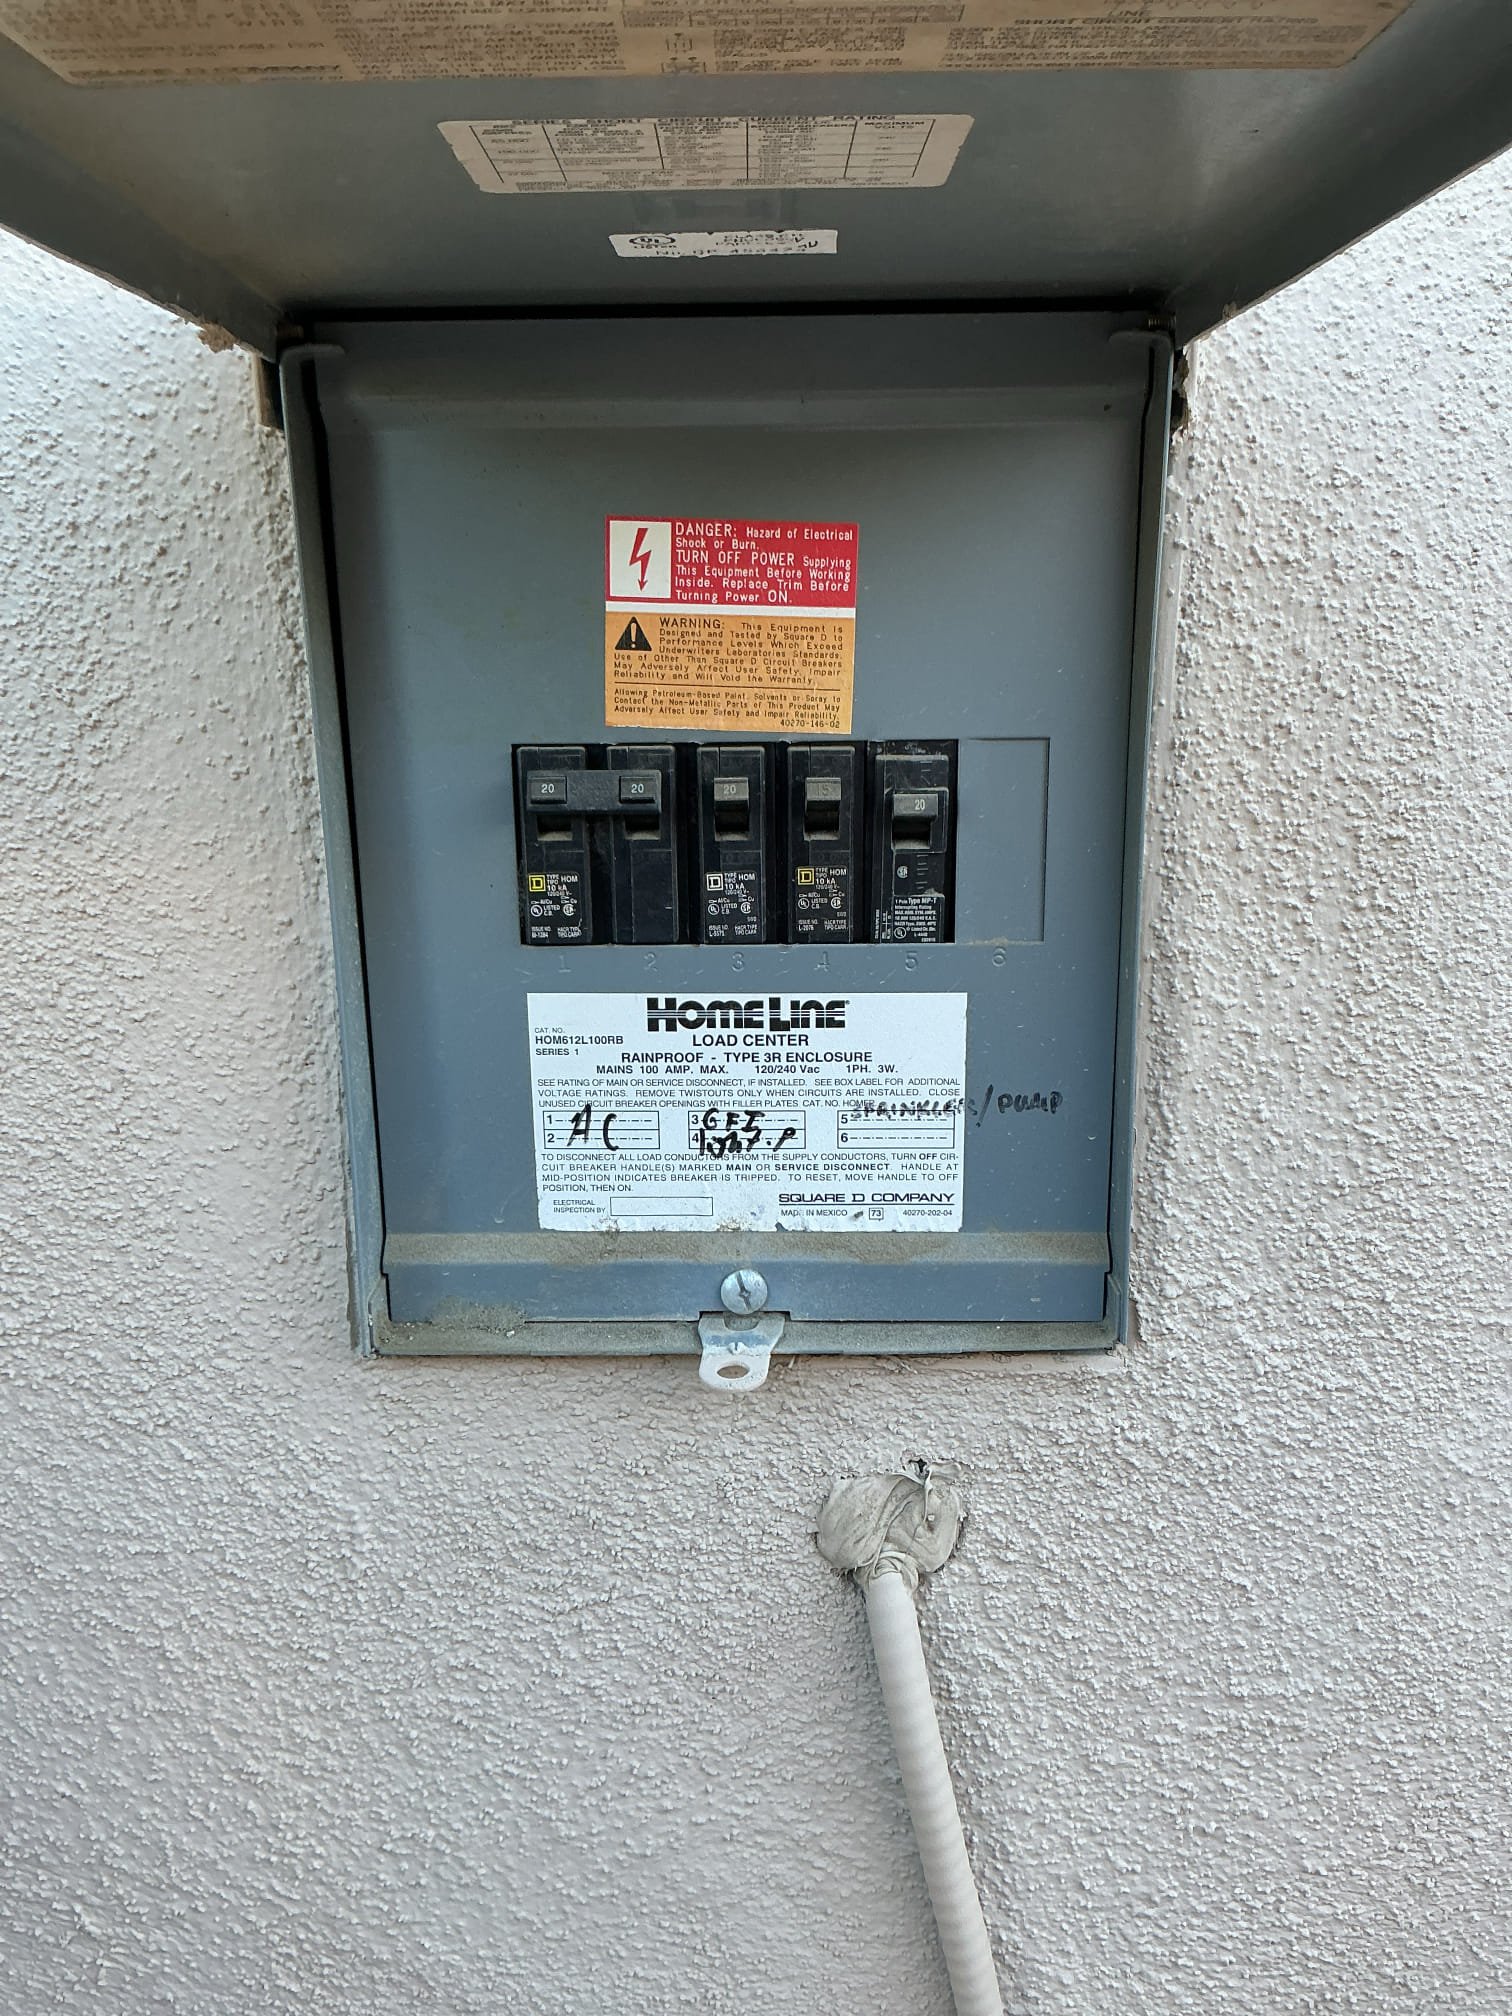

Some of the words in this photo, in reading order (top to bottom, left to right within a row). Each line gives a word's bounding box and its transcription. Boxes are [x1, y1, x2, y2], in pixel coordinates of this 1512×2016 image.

[675, 522, 737, 537] DANGER:
[746, 527, 781, 539] Hazard
[787, 528, 797, 539] of
[804, 528, 853, 541] Electrical
[675, 537, 706, 549] Shock
[713, 541, 724, 549] or
[731, 539, 760, 550] Burn.
[675, 549, 709, 564] TURN
[718, 551, 742, 565] OFF
[751, 551, 795, 566] POWER
[803, 555, 851, 571] Supplying
[676, 564, 697, 576] This
[704, 565, 760, 578] Equipment
[767, 567, 802, 579] Before
[809, 568, 851, 583] Working
[675, 576, 714, 588] Inside.
[722, 577, 769, 591] Replace
[777, 579, 803, 591] Trim
[810, 580, 849, 592] Before
[675, 590, 718, 604] Turning
[725, 591, 760, 602] Power
[767, 589, 793, 604] ON.
[659, 617, 725, 630] WARNING:
[741, 622, 762, 631] This
[770, 623, 826, 633] Equipment
[659, 628, 701, 639] Designed
[707, 629, 723, 638] and
[730, 631, 761, 640] Tested
[783, 632, 815, 642] Square
[820, 634, 827, 642] D
[659, 637, 723, 647] Performance
[730, 640, 763, 648] Levels
[770, 640, 800, 649] Which
[806, 642, 843, 651] Exceed
[745, 709, 760, 718] and
[541, 784, 555, 794] 20
[630, 783, 645, 794] 20
[723, 784, 737, 795] 20
[914, 799, 926, 811] 20
[738, 873, 756, 881] HOM
[829, 868, 847, 876] HOM
[560, 875, 579, 883] HOM
[643, 952, 658, 972] 2
[730, 951, 745, 973] 3
[904, 951, 919, 972] 5
[991, 947, 1007, 968] 6
[559, 954, 572, 973] 1
[535, 1035, 624, 1045] HOM612L100RB
[692, 1034, 737, 1047] LOAD
[742, 1033, 810, 1047] CENTER
[535, 1048, 570, 1056] SERIES
[574, 1048, 579, 1056] 1
[621, 1052, 704, 1063] RAINPROOF
[724, 1052, 761, 1063] TYPE
[763, 1052, 782, 1063] 3R
[785, 1051, 873, 1063] ENCLOSURE
[596, 1065, 633, 1075] MAINS
[639, 1065, 659, 1074] 100
[664, 1065, 694, 1074] AMP.
[700, 1065, 729, 1074] MAX.
[754, 1065, 797, 1074] 120/240
[800, 1065, 821, 1074] Vac
[845, 1065, 872, 1074] 1PH.
[877, 1064, 899, 1074] 3W.
[537, 1078, 556, 1087] SEE
[557, 1078, 590, 1087] RATING
[592, 1078, 605, 1087] OF
[606, 1078, 629, 1087] MAIN
[630, 1078, 644, 1087] OR
[645, 1078, 684, 1087] SERVICE
[685, 1078, 746, 1089] DISCONNECT,
[748, 1078, 757, 1087] IF
[758, 1078, 808, 1087] INSTALLED.
[814, 1078, 833, 1086] SEE
[834, 1078, 854, 1086] BOX
[855, 1078, 884, 1086] LABEL
[884, 1078, 904, 1086] FOR
[907, 1078, 961, 1086] ADDITIONAL
[538, 1089, 582, 1097] VOLTAGE
[635, 1089, 676, 1097] REMOVE
[678, 1089, 734, 1097] TWISTOUTS
[736, 1089, 764, 1097] ONLY
[765, 1089, 795, 1097] WHEN
[798, 1089, 842, 1097] CIRCUITS
[845, 1089, 865, 1097] ARE
[868, 1088, 921, 1097] INSTALLED.
[928, 1088, 960, 1096] CLOSE
[547, 1115, 553, 1125] 1
[691, 1114, 699, 1125] 3
[840, 1115, 849, 1124] 5
[547, 1134, 556, 1143] 2
[840, 1133, 849, 1142] 6
[541, 1163, 565, 1172] CUIT
[569, 1163, 617, 1172] BREAKER
[620, 1163, 676, 1172] HANDLE(S)
[679, 1163, 722, 1172] MARKED
[726, 1163, 752, 1171] MAIN
[755, 1163, 771, 1172] OR
[774, 1163, 822, 1171] SERVICE
[901, 1163, 942, 1171] HANDLE
[946, 1163, 960, 1171] AT
[778, 1193, 846, 1204] SQUARE
[851, 1193, 865, 1203] D
[871, 1193, 955, 1203] COMPANY
[870, 1209, 882, 1217] 73
